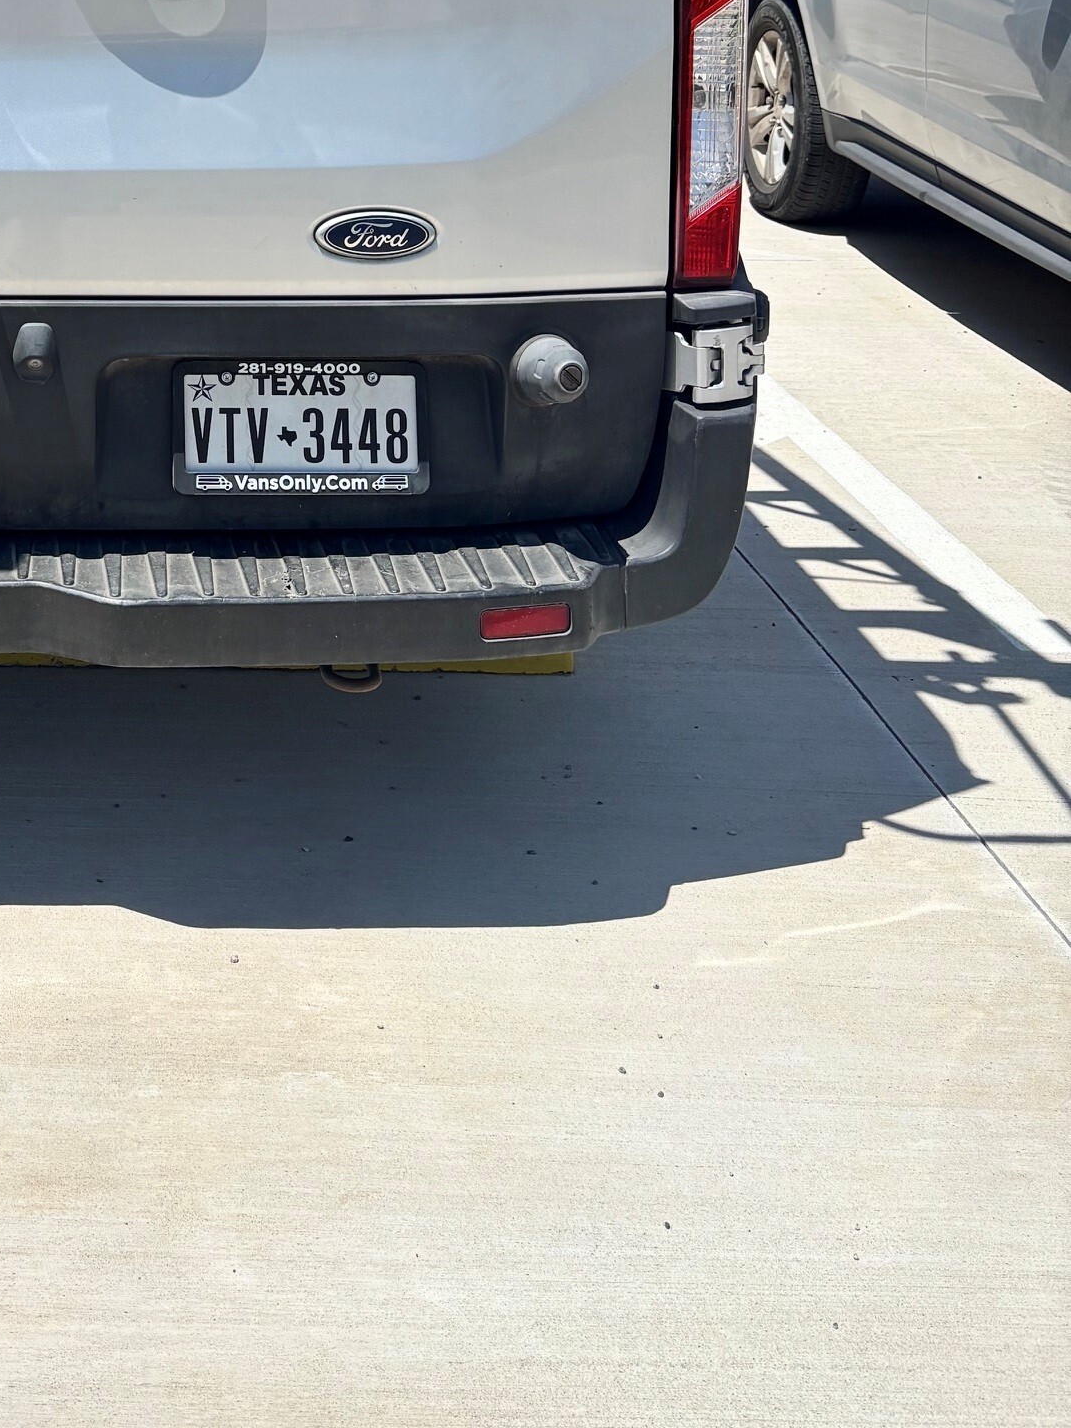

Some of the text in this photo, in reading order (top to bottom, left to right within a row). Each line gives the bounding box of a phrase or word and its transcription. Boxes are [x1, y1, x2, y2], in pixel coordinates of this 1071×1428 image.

[344, 222, 410, 248] Ford
[238, 362, 361, 374] 281-919-4000
[252, 374, 346, 396] TEXAS
[191, 407, 409, 464] VTV 3448
[234, 474, 369, 493] VansOnly.Com
